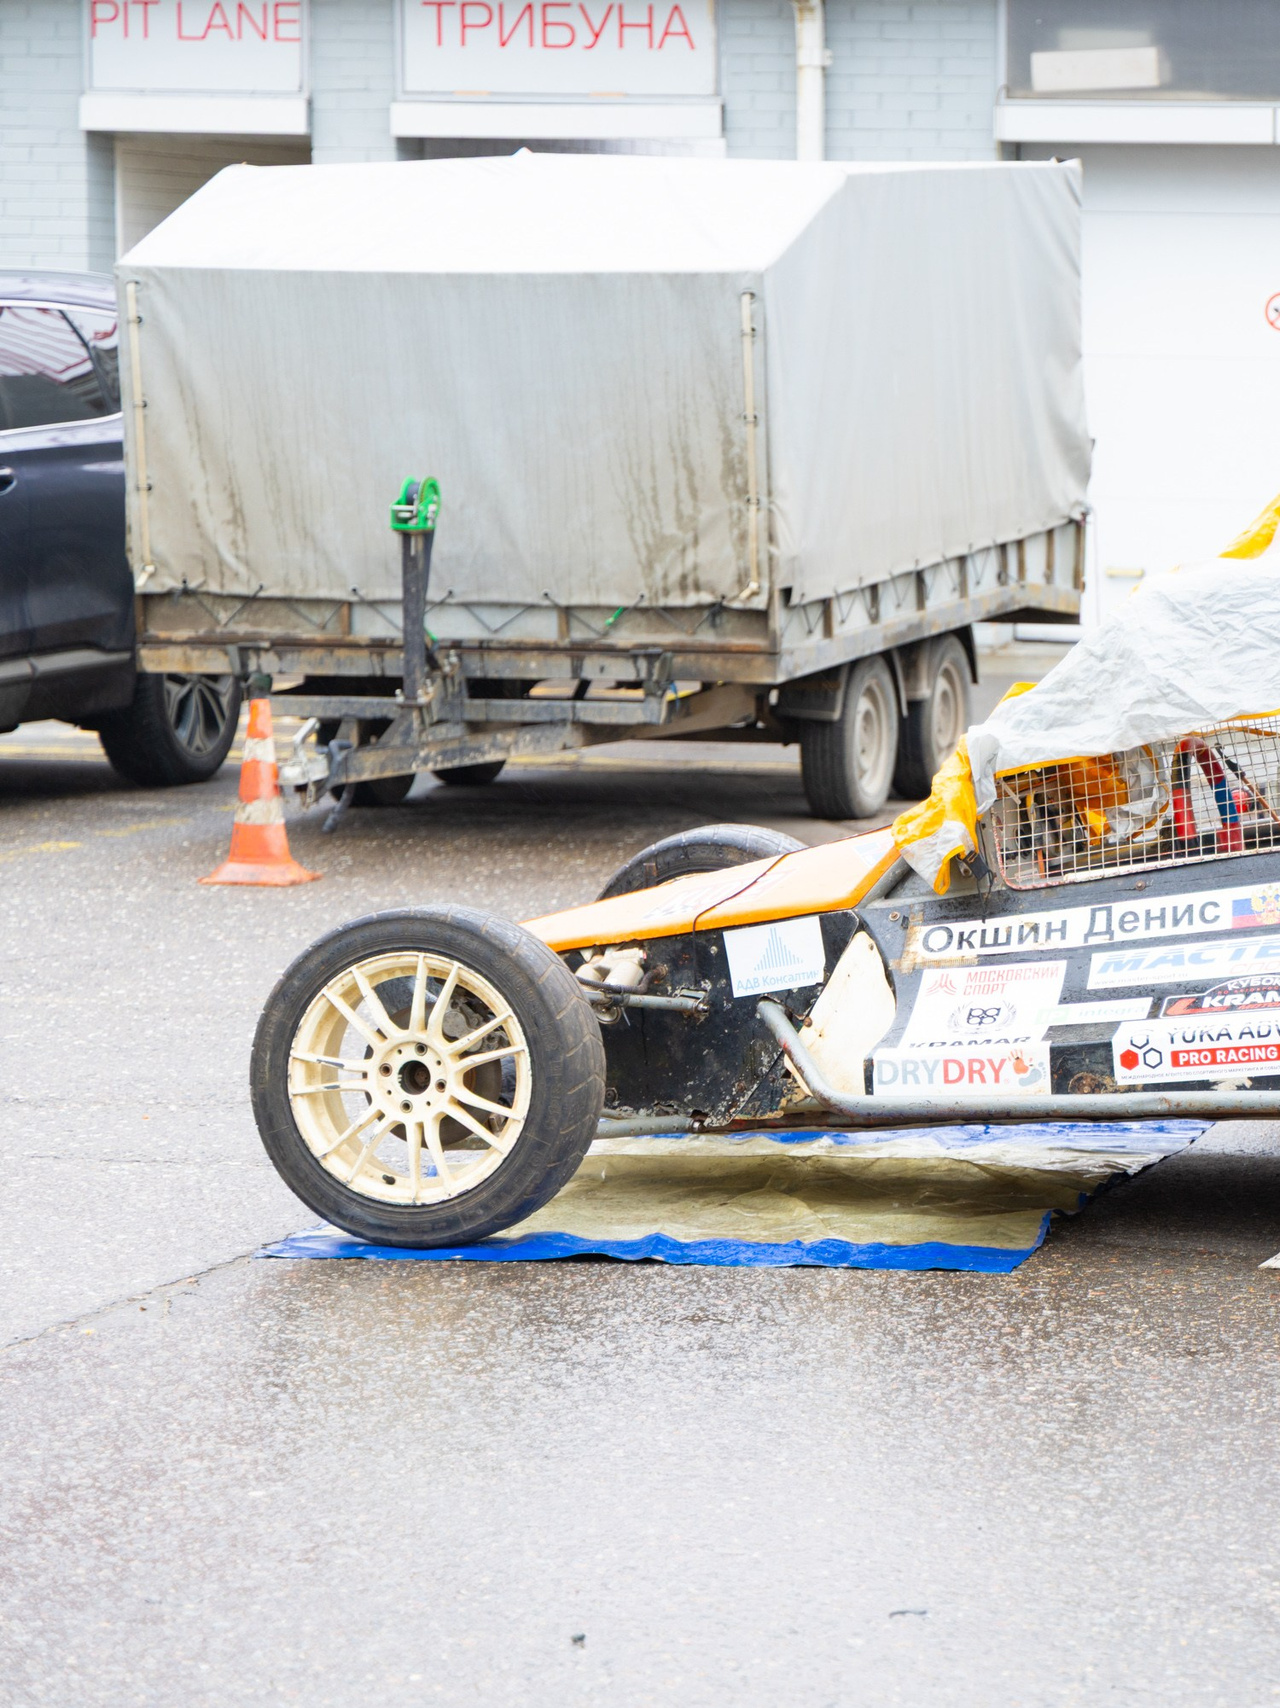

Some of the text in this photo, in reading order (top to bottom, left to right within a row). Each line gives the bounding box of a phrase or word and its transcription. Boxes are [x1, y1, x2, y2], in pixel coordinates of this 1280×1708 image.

[91, 0, 301, 42] PIT LANE
[421, 1, 696, 50] ТРИБУНА
[922, 901, 1221, 954] Окшин Денис
[963, 982, 1008, 996] СПОРТ
[966, 966, 1060, 983] МОСКОВСКИЙ
[1178, 1046, 1279, 1066] PRO RACING
[876, 1057, 1007, 1086] DRYDRY
